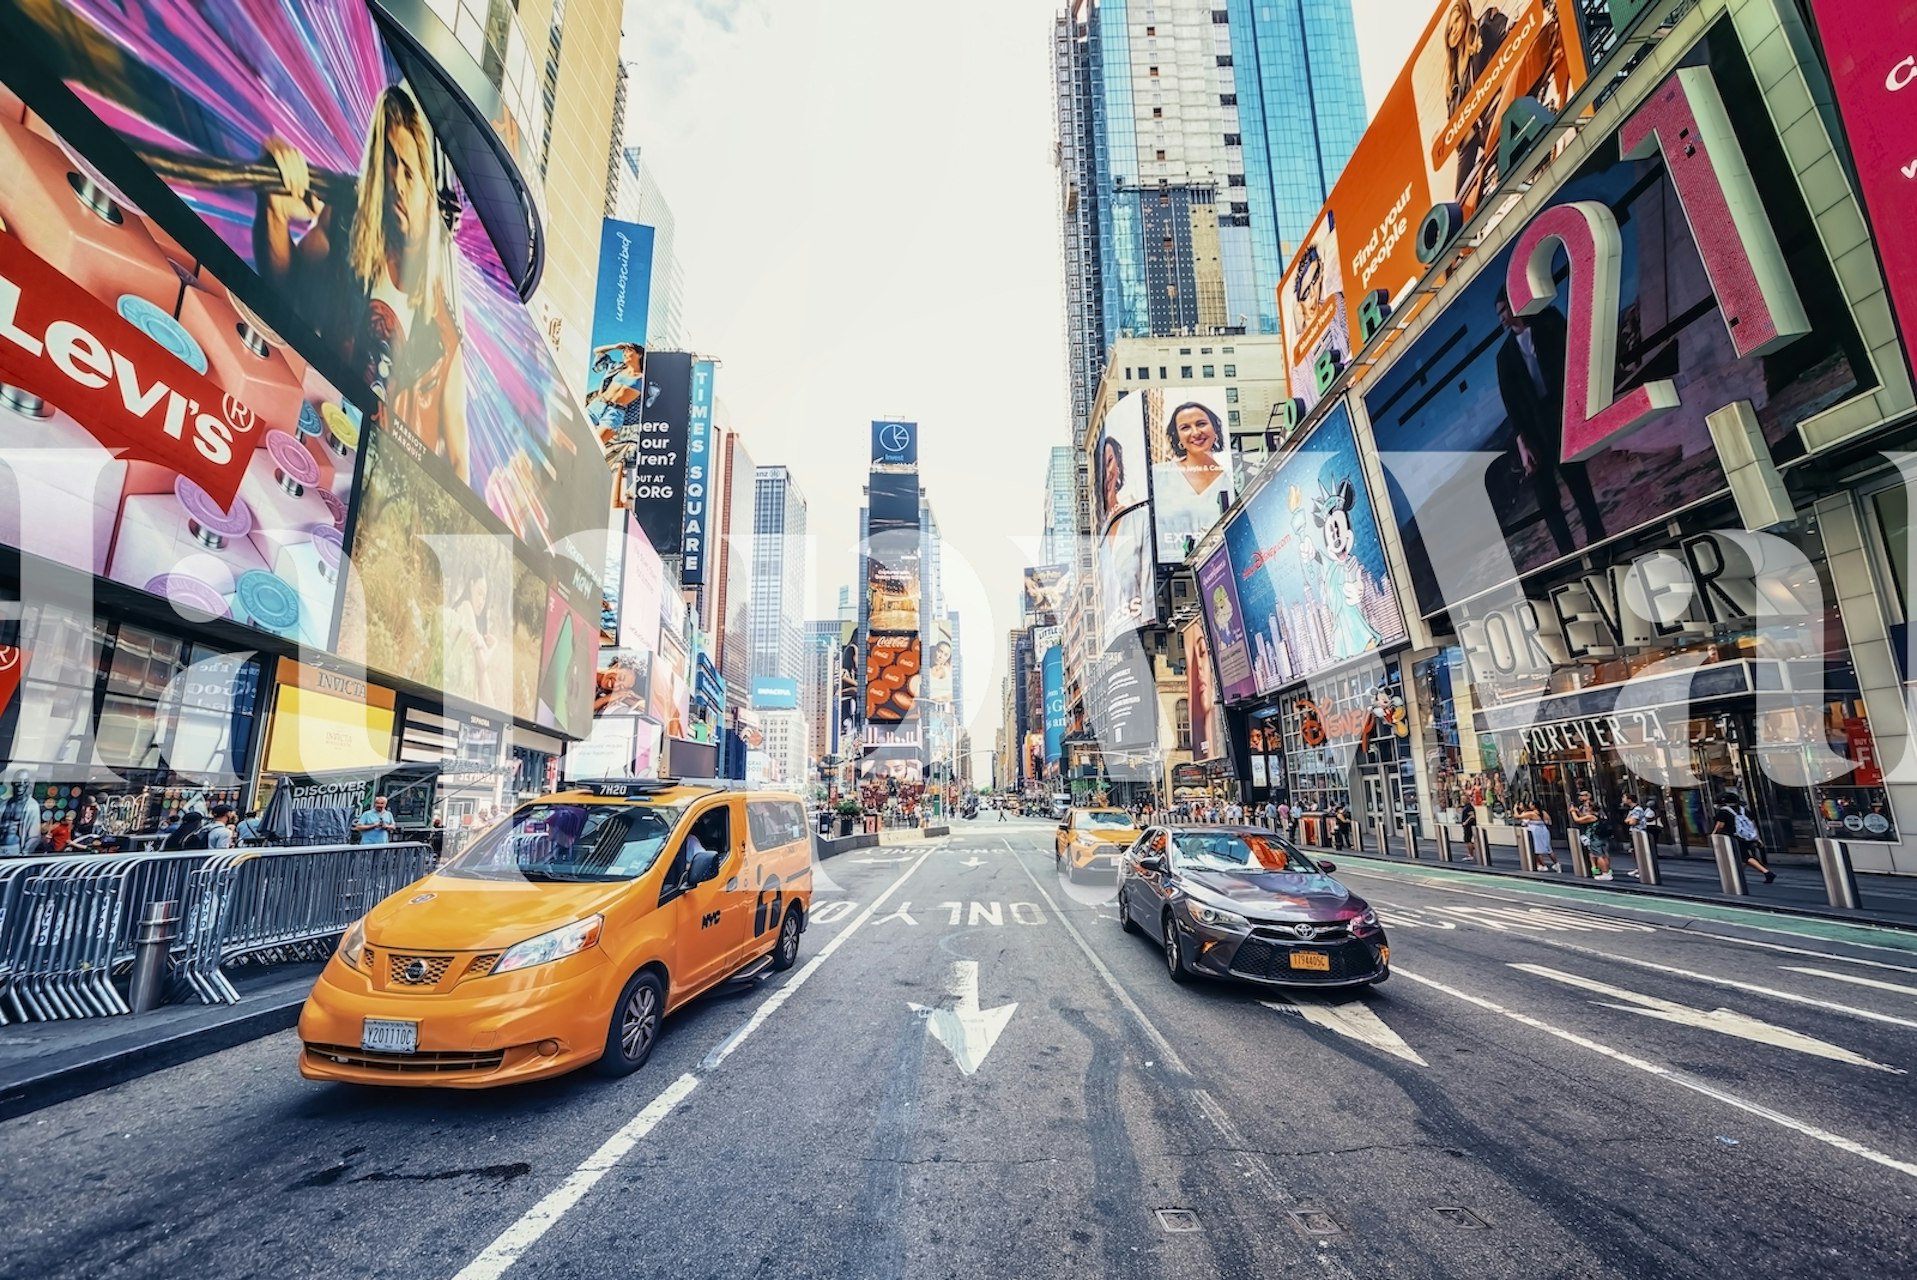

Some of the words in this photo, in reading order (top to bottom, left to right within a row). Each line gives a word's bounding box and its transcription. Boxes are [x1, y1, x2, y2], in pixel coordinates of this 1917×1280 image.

[1352, 227, 1379, 277] Find
[1379, 181, 1413, 242] your
[1361, 216, 1408, 290] people
[1506, 64, 1812, 464] 21
[616, 231, 632, 323] unsubscribed
[690, 371, 708, 453] TIMES
[392, 429, 422, 462] MARQUIS
[394, 418, 427, 455] MARRIOTT
[641, 438, 670, 449] our
[654, 475, 665, 483] AT
[684, 465, 704, 572] SQUARE
[1455, 530, 1757, 685] FOREVER
[318, 671, 367, 699] INVICTA
[1518, 714, 1629, 755] FOREVER
[1633, 707, 1667, 743] 21
[293, 780, 367, 798] DISCOVER
[599, 784, 628, 795] 7H20
[200, 891, 211, 928] NYPD
[701, 910, 721, 930] NYC
[871, 900, 1050, 926] ONLY
